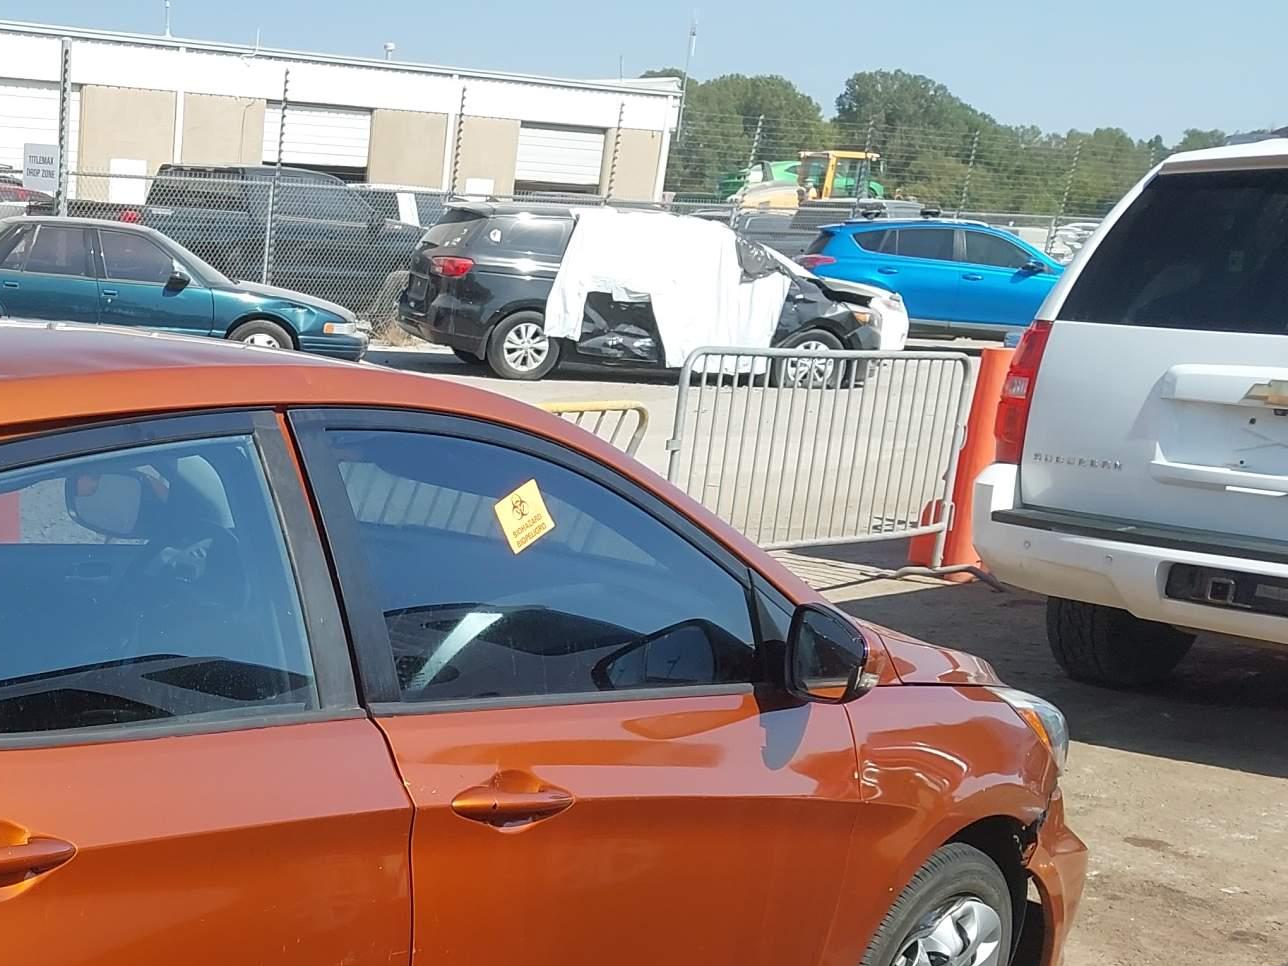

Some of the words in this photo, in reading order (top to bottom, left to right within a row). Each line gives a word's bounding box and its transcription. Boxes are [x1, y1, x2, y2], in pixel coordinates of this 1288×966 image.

[26, 168, 41, 178] DROP
[41, 169, 55, 179] ZONE
[513, 513, 543, 538] BIOHAZARD
[517, 522, 547, 548] BIOPELIGRO
